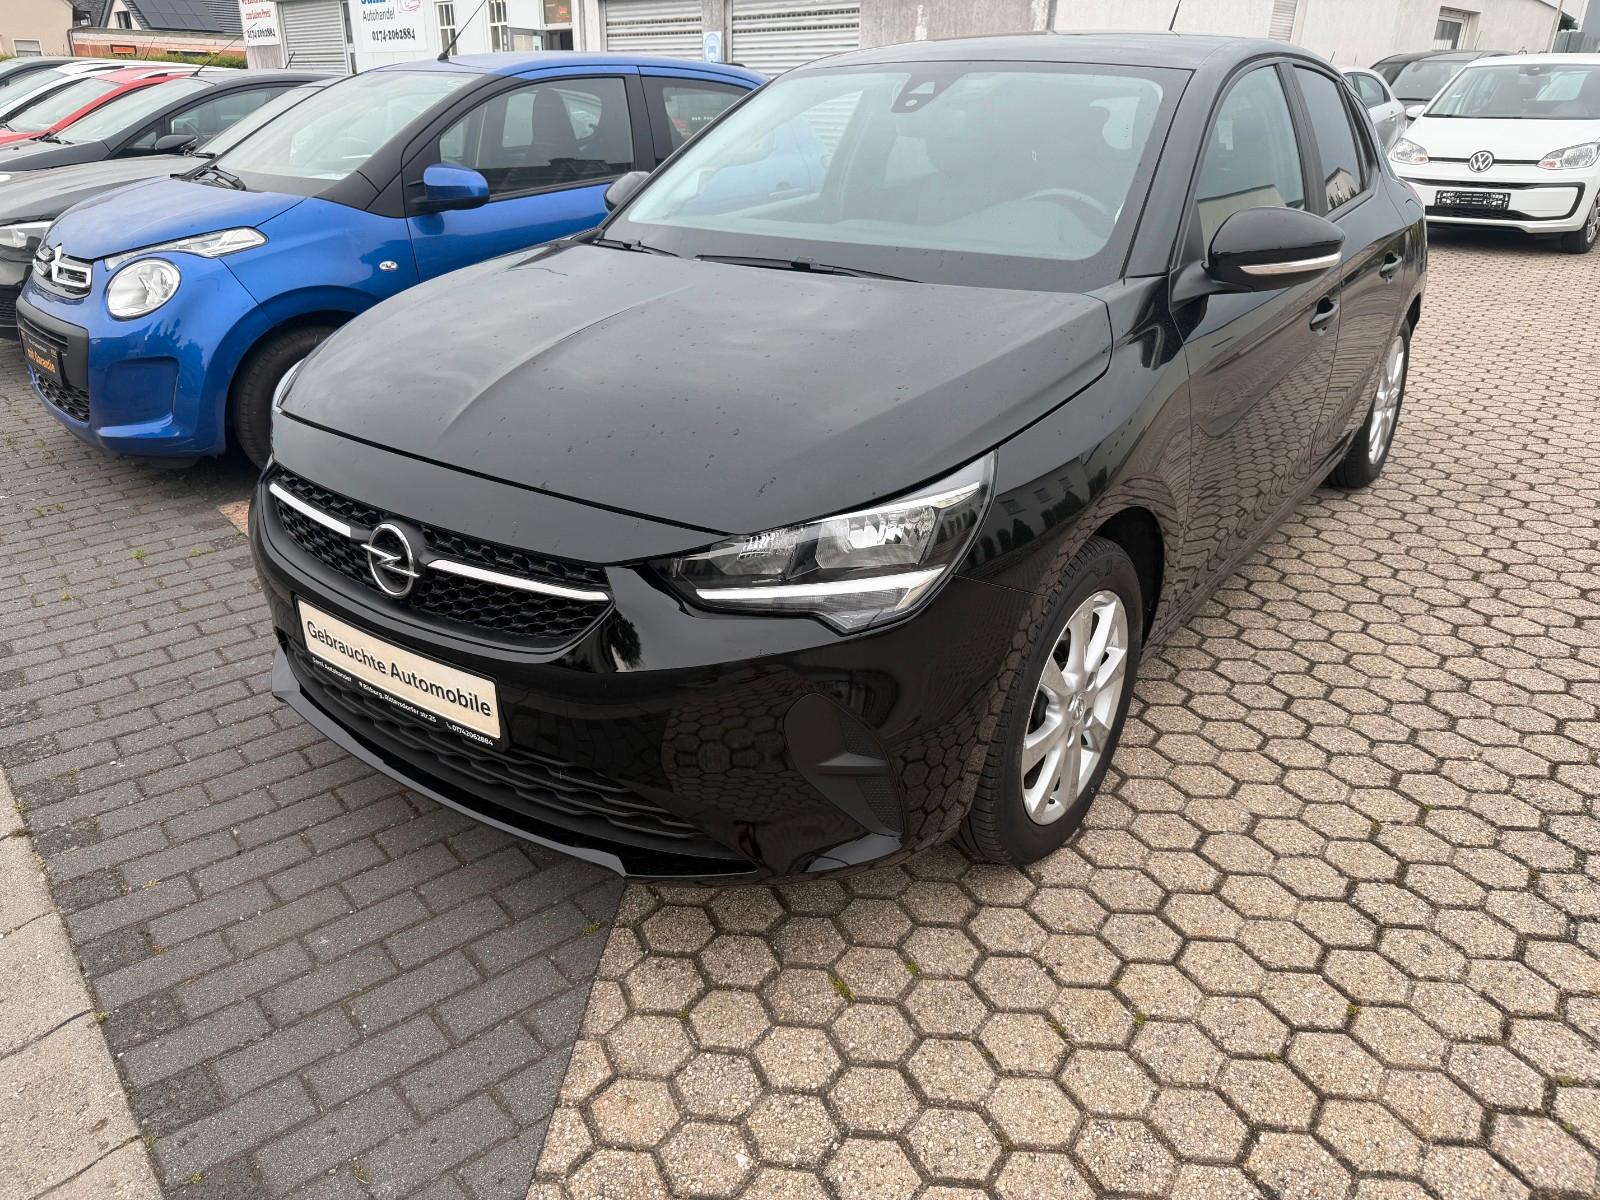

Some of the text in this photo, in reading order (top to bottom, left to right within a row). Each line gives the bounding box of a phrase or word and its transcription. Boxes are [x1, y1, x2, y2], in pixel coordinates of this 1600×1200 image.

[362, 8, 395, 21] Autohandel
[372, 28, 416, 42] 0174-2062884
[307, 620, 492, 717] Gebrauchte Automobile
[452, 724, 494, 747] 01742062884
